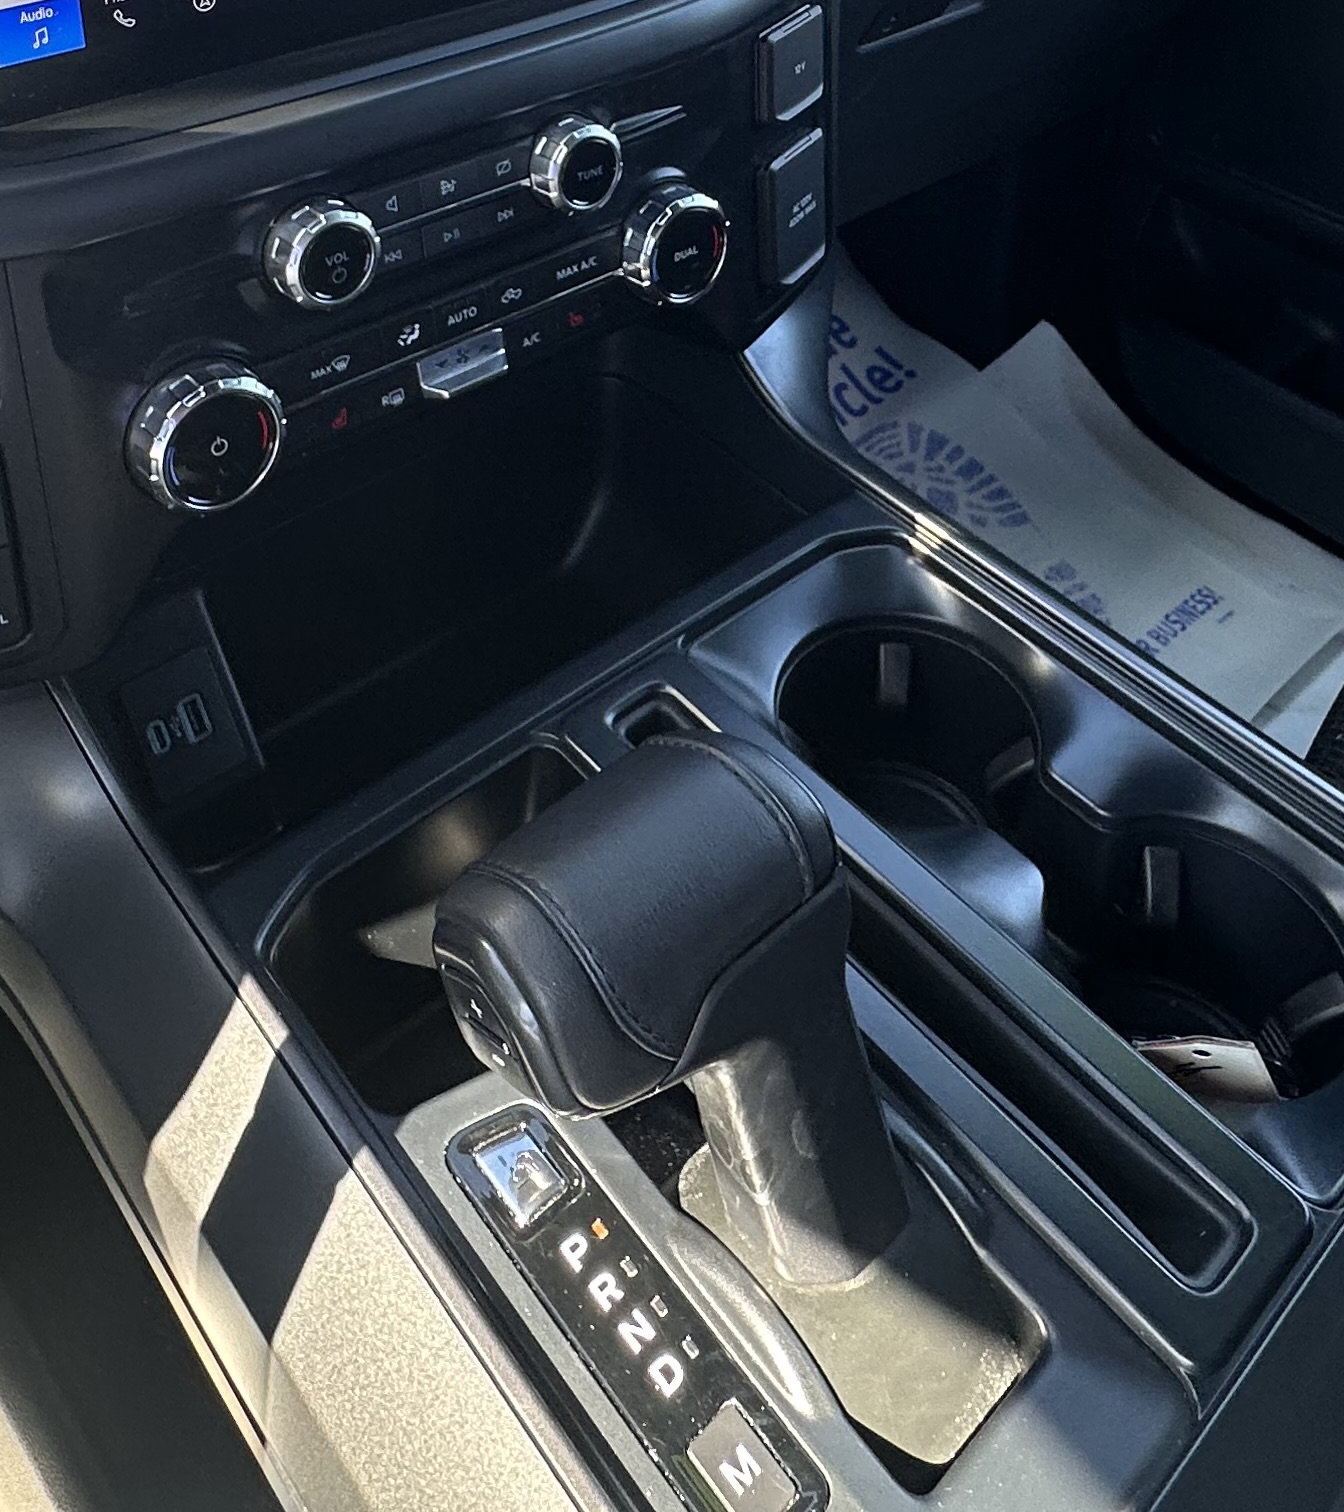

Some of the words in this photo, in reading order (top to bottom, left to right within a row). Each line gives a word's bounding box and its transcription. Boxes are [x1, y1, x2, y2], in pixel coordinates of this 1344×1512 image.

[19, 6, 55, 24] Audio
[577, 165, 604, 182] TUNE
[324, 251, 350, 267] VOL
[674, 245, 699, 263] DUAL
[556, 262, 580, 281] MAX
[577, 255, 599, 274] A/C
[447, 305, 478, 326] AUTO
[522, 332, 542, 349] A/C
[310, 364, 333, 381] MAX
[559, 1231, 588, 1274] P
[587, 1271, 624, 1313] R
[616, 1309, 656, 1355] N
[647, 1352, 686, 1398] D
[717, 1441, 763, 1497] M
